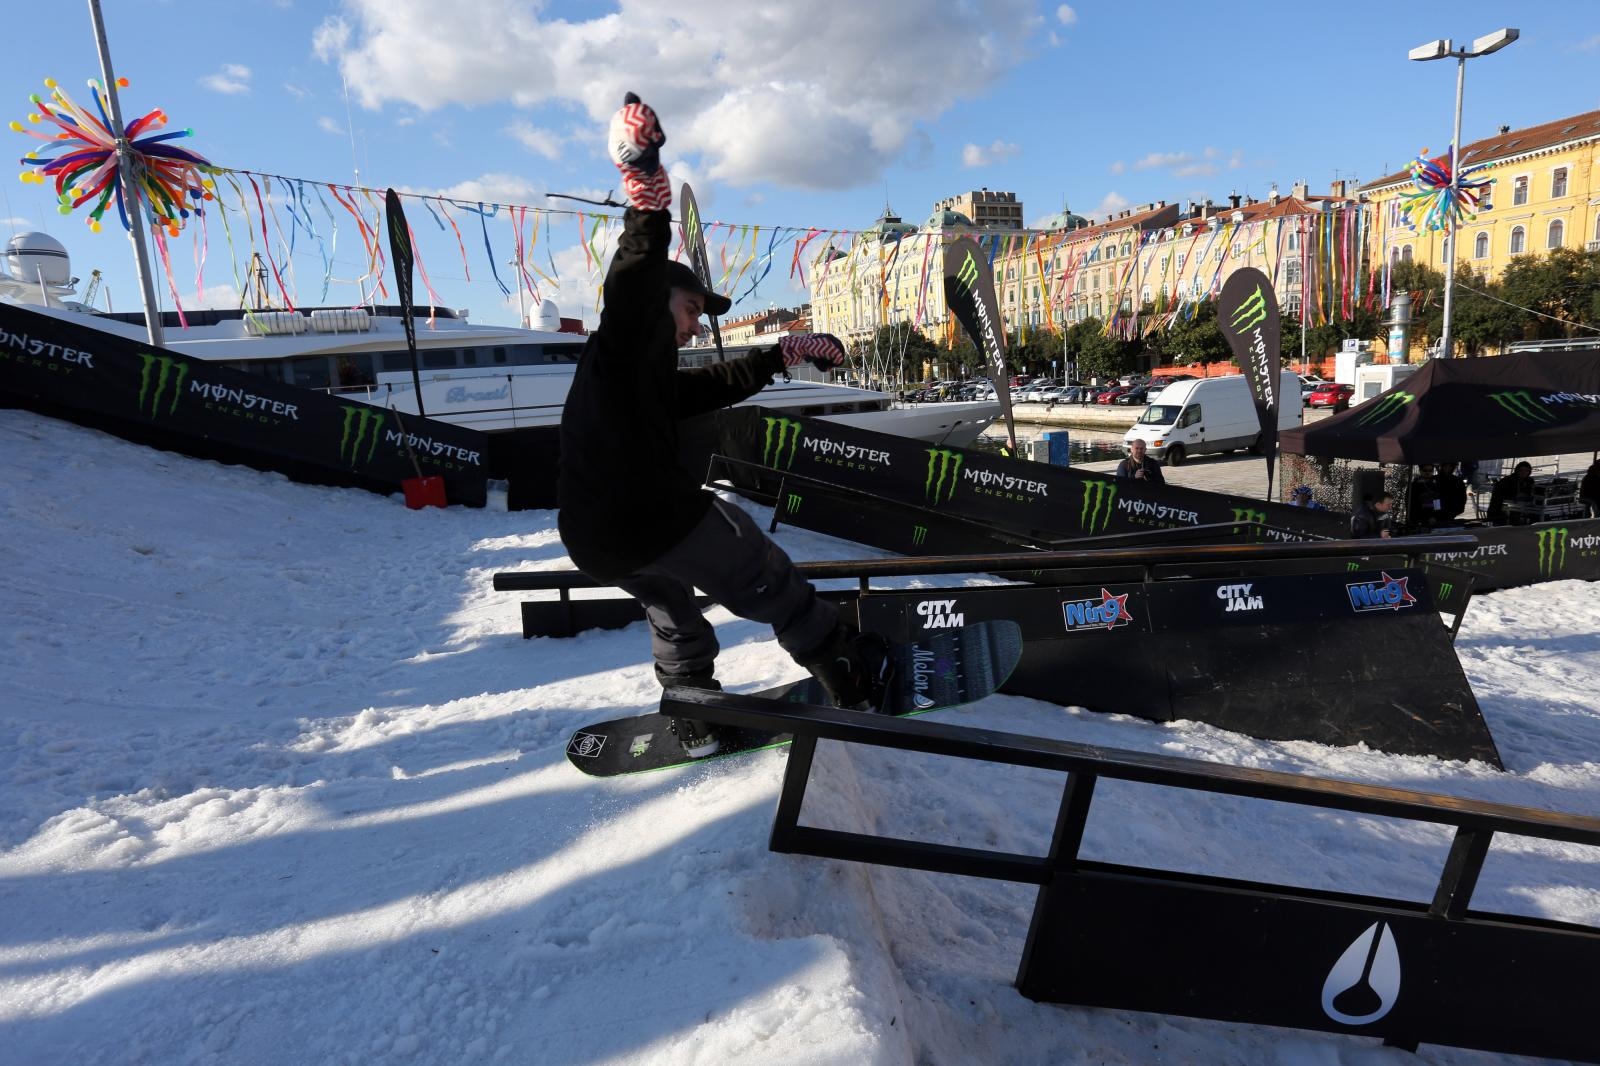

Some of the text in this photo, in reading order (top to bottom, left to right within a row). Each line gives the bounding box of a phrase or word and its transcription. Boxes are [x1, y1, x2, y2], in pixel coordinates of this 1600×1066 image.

[972, 288, 1004, 376] MONSTER
[1249, 347, 1263, 401] ENERGY
[1253, 327, 1274, 410] MONSTER
[190, 380, 299, 420] MONSTER
[205, 402, 280, 425] ENERGY
[398, 450, 464, 471] EERGY
[803, 436, 891, 466] MONSTER
[814, 455, 876, 472] ENERGY
[964, 468, 1048, 497] MONSTER
[975, 486, 1034, 503] ENERGY
[1118, 498, 1199, 525] MONSTER
[1217, 584, 1253, 599] CITY
[1225, 596, 1264, 612] JAM
[917, 600, 957, 615] CITY
[923, 613, 964, 629] JAM
[912, 643, 935, 692] Melon
